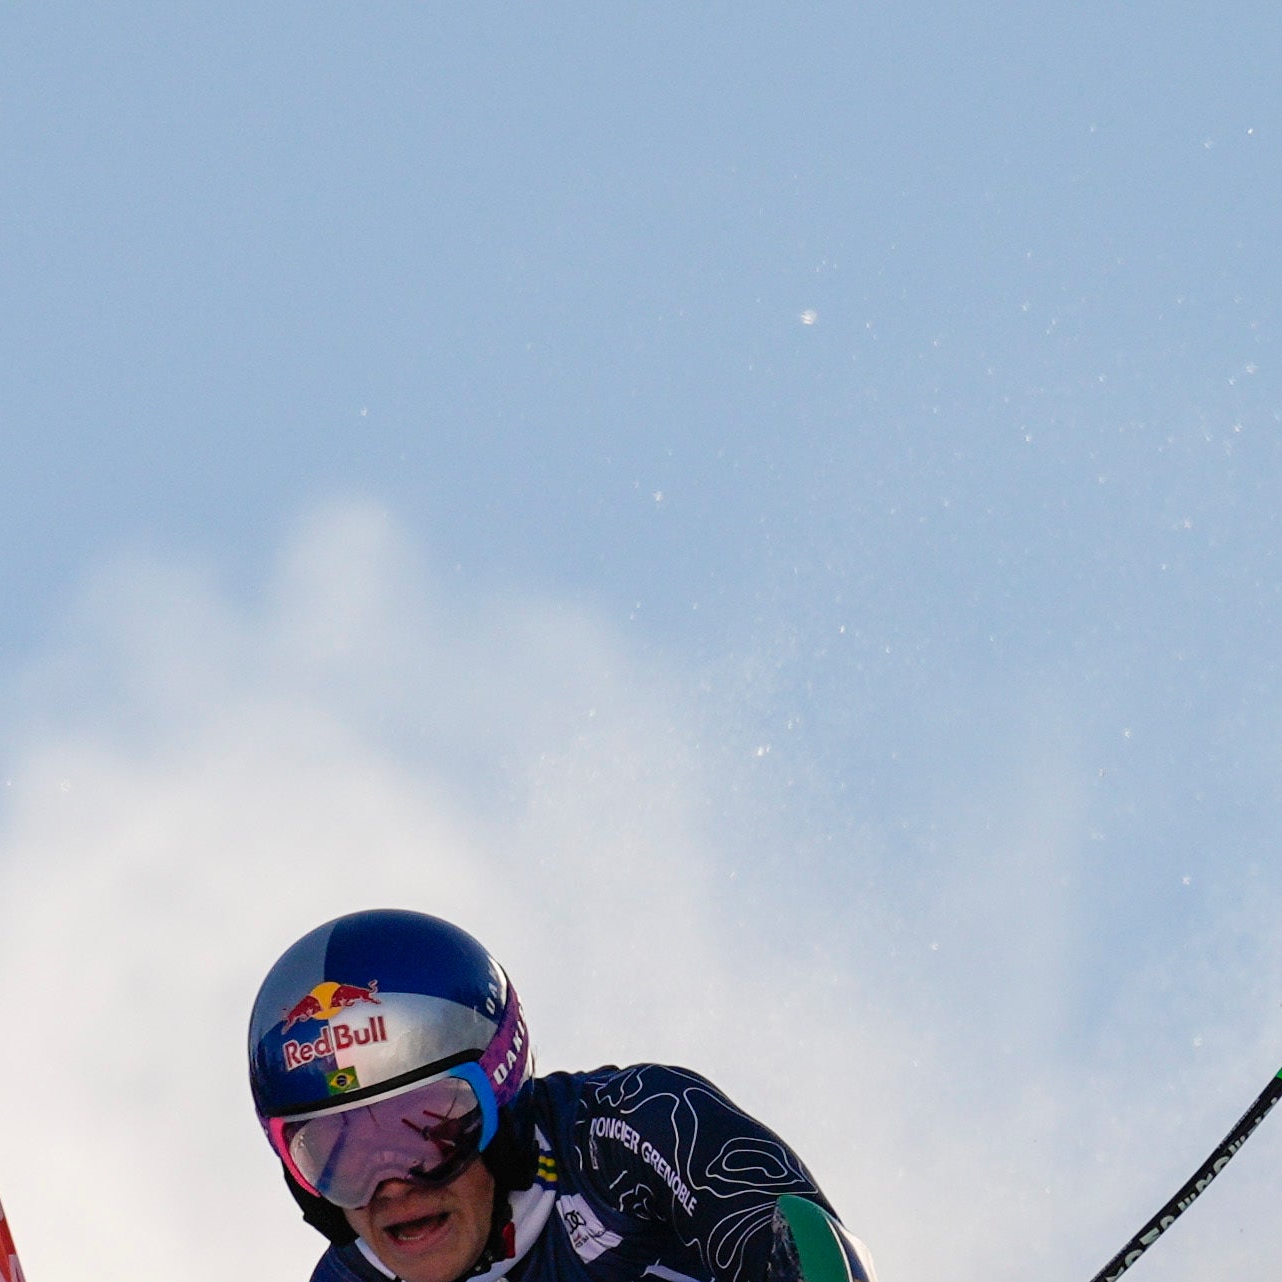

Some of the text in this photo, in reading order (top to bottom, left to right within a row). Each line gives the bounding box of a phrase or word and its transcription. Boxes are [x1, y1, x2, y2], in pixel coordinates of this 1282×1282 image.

[282, 1015, 388, 1071] Red Bull
[640, 1141, 698, 1218] GRENOBLE
